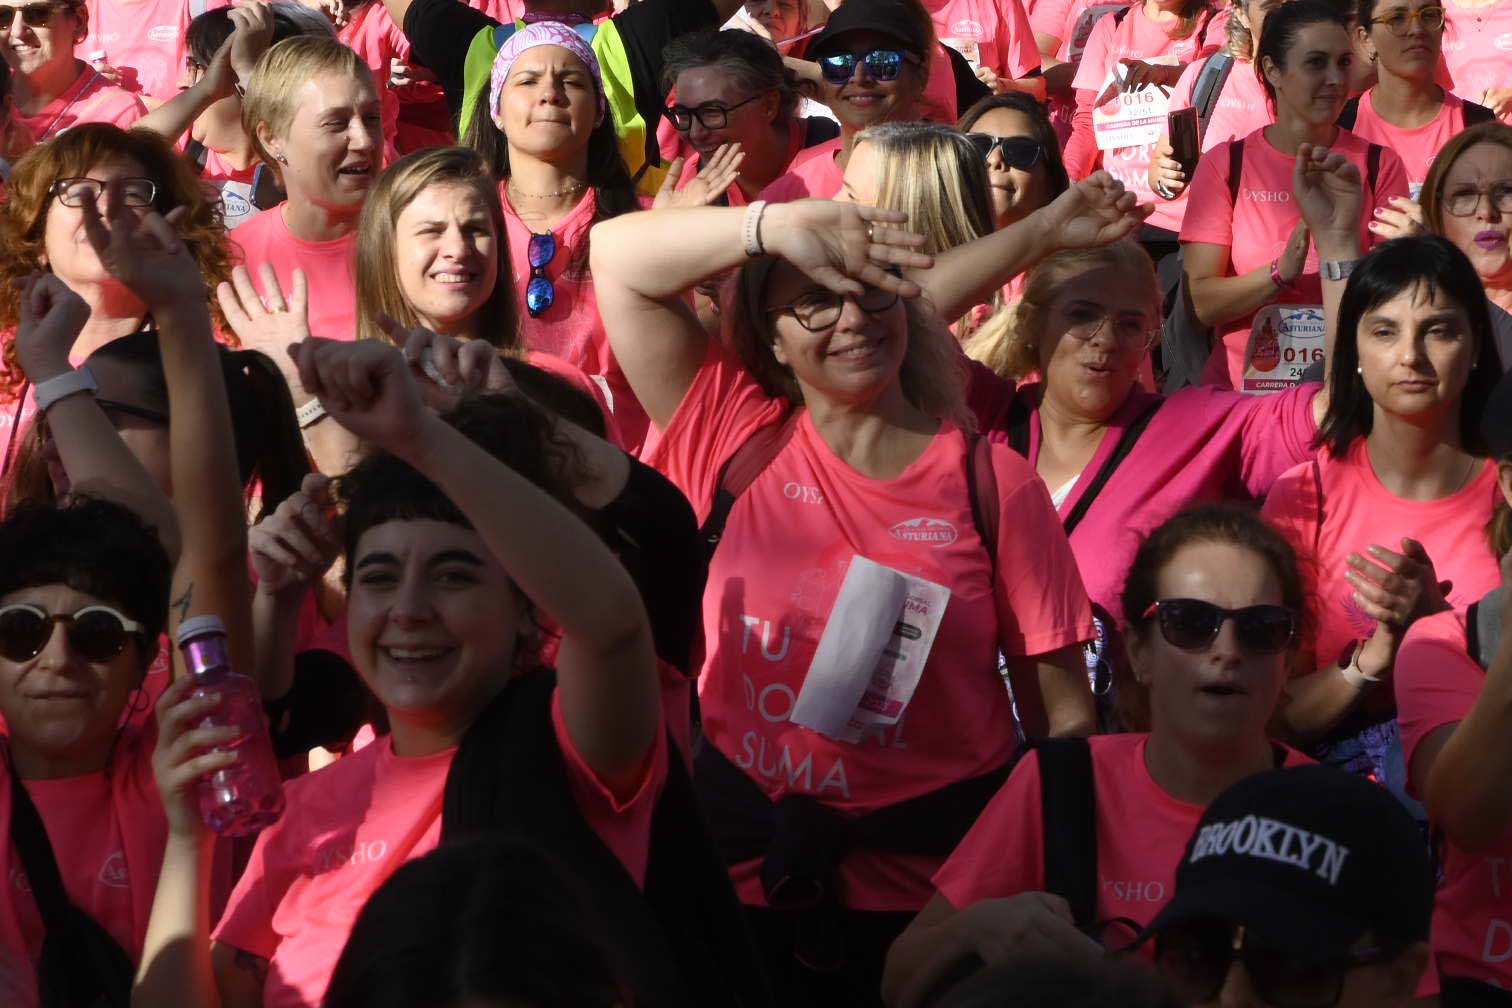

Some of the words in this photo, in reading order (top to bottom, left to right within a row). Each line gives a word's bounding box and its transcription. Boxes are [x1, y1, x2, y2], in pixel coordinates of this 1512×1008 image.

[1123, 92, 1154, 106] 016
[1243, 189, 1290, 203] OYSHO
[1283, 347, 1324, 363] 016
[1255, 380, 1286, 389] CARRERA
[894, 527, 953, 544] ASTURIANA
[738, 614, 792, 663] TU
[734, 740, 850, 799] SUMA
[1189, 815, 1349, 885] BROOKLYN
